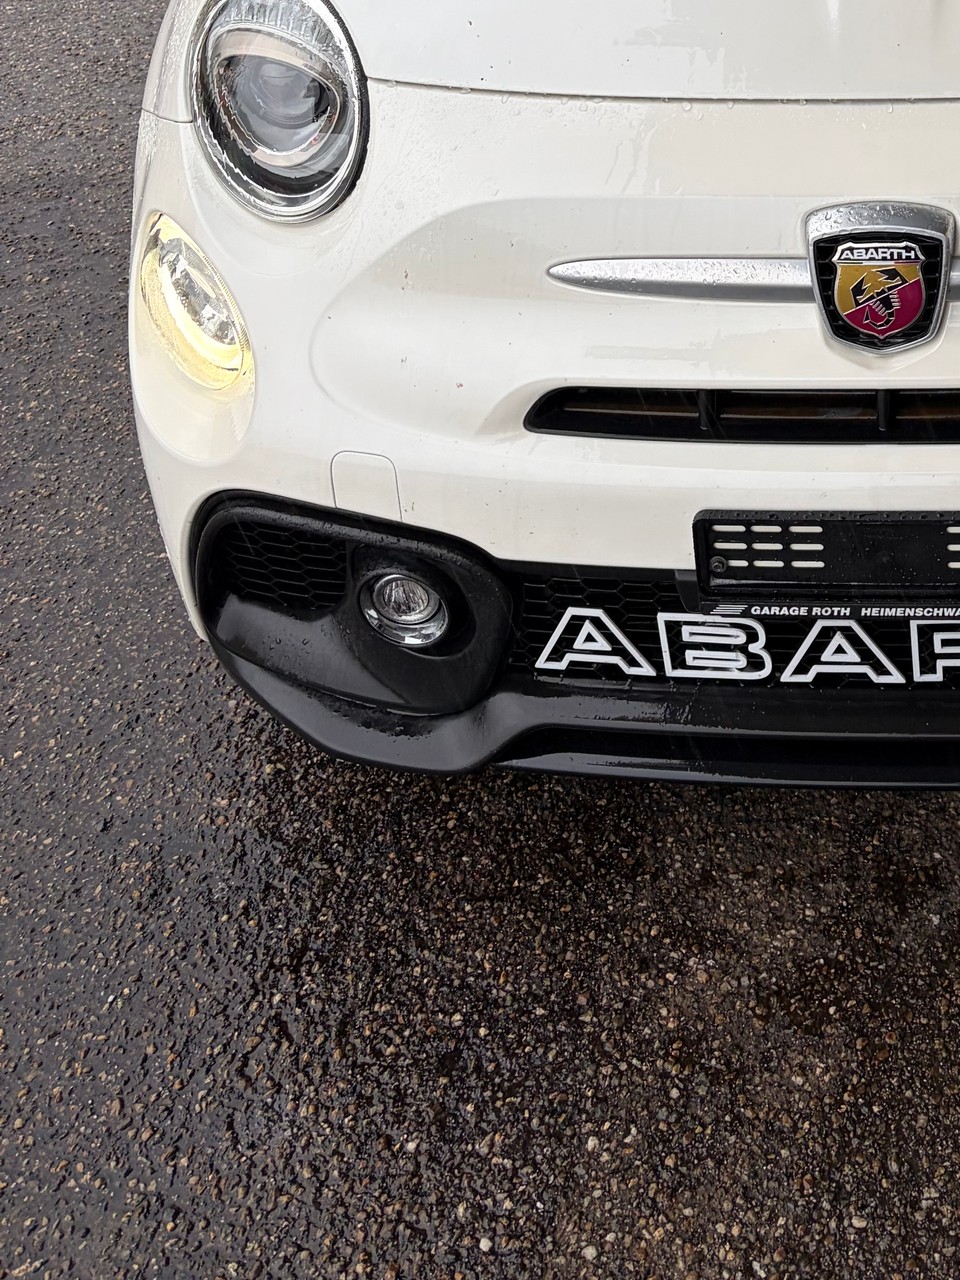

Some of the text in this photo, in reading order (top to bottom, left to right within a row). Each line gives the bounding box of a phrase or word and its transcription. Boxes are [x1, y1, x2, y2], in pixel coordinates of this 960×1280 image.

[841, 248, 915, 260] ABARTH
[751, 606, 808, 616] GARAGE
[812, 606, 851, 616] ROTH
